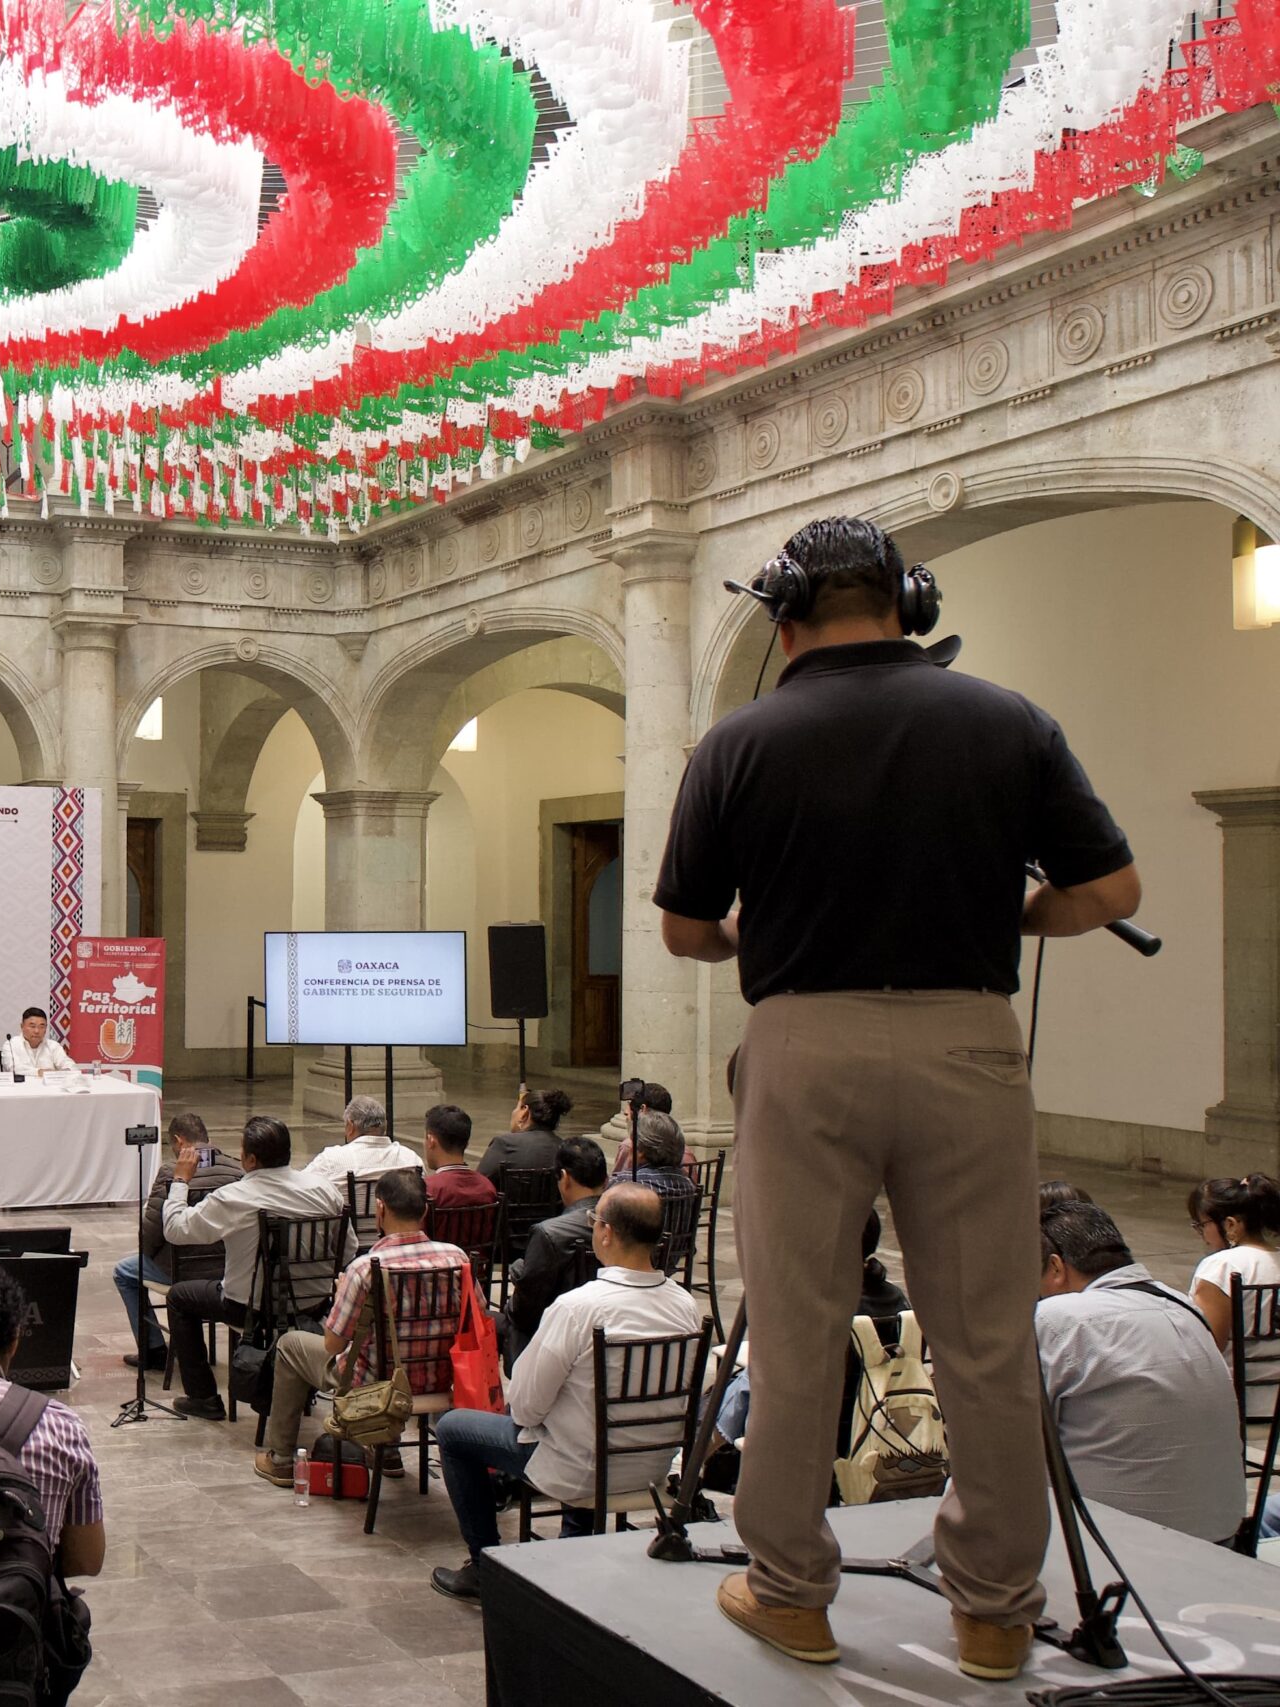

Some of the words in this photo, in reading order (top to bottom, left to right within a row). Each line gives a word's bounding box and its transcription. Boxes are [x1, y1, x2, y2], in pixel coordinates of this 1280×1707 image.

[355, 962, 400, 970] OAXACA
[304, 978, 370, 986] CONFERENCIA
[372, 978, 385, 986] DE
[388, 978, 425, 986] PRENSA
[428, 978, 441, 986] DE
[82, 990, 112, 1004] Paz
[303, 988, 358, 996] GABINETE
[360, 988, 375, 997] DE
[377, 988, 443, 997] SEGURIDAD
[79, 1003, 156, 1015] Territorial
